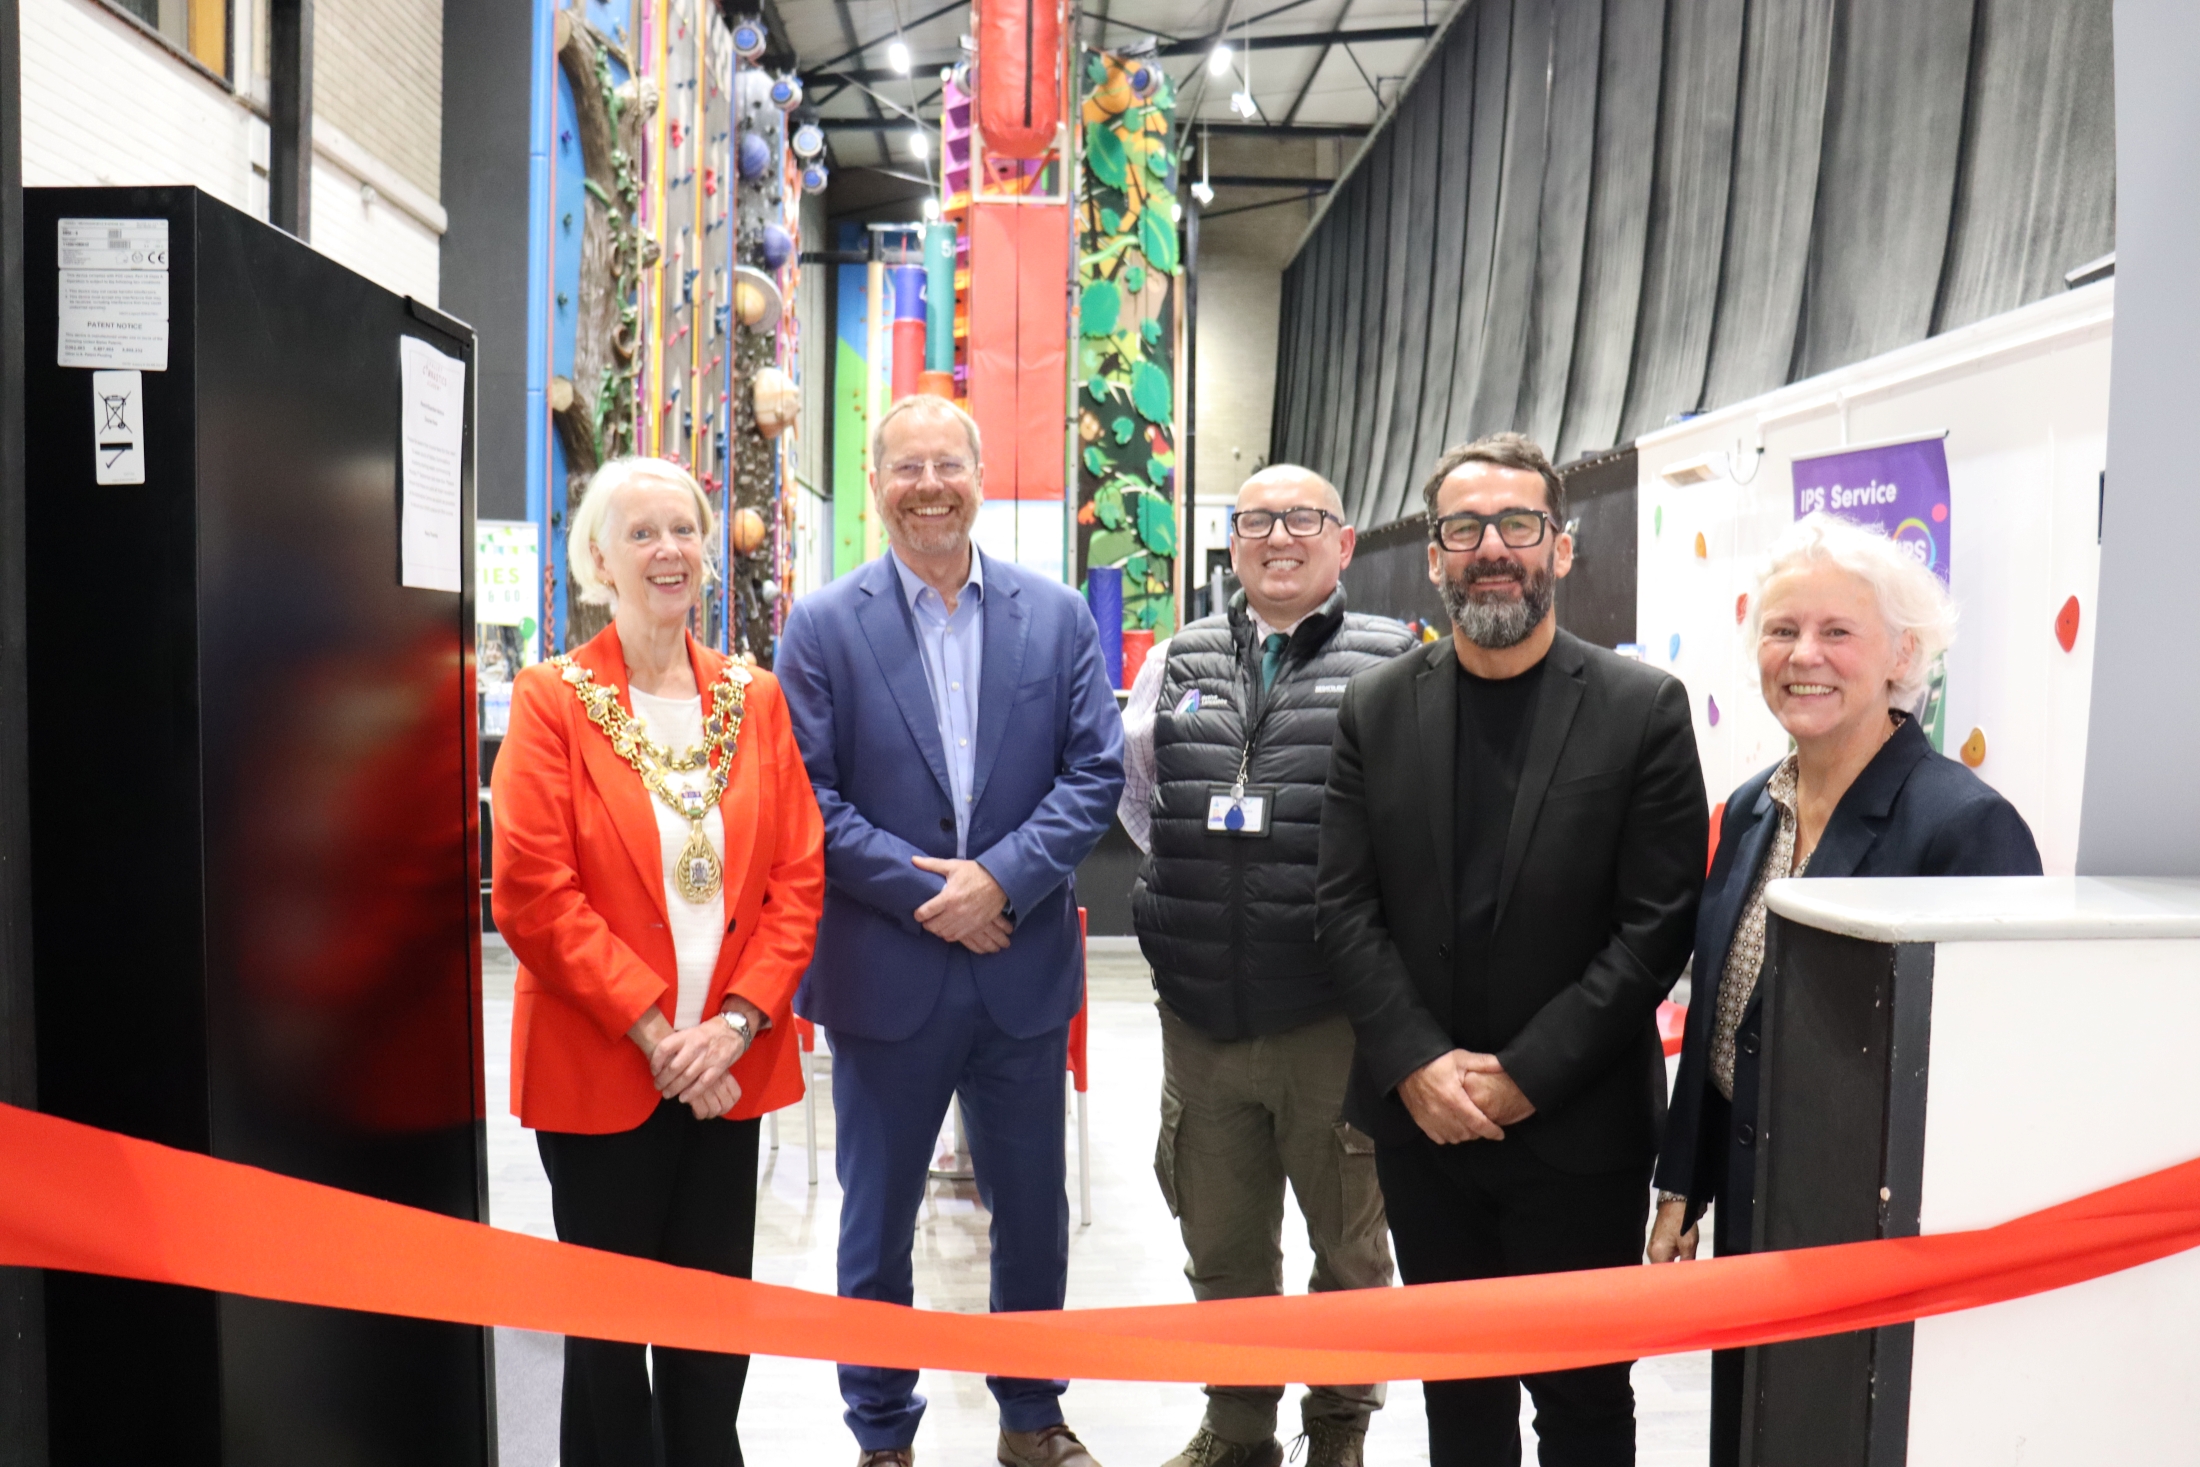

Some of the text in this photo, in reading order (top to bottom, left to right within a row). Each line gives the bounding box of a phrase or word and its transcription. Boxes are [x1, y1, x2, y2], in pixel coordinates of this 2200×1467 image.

[87, 321, 114, 329] PATENT
[1801, 479, 1897, 512] IPS Service
[505, 589, 520, 602] GO
